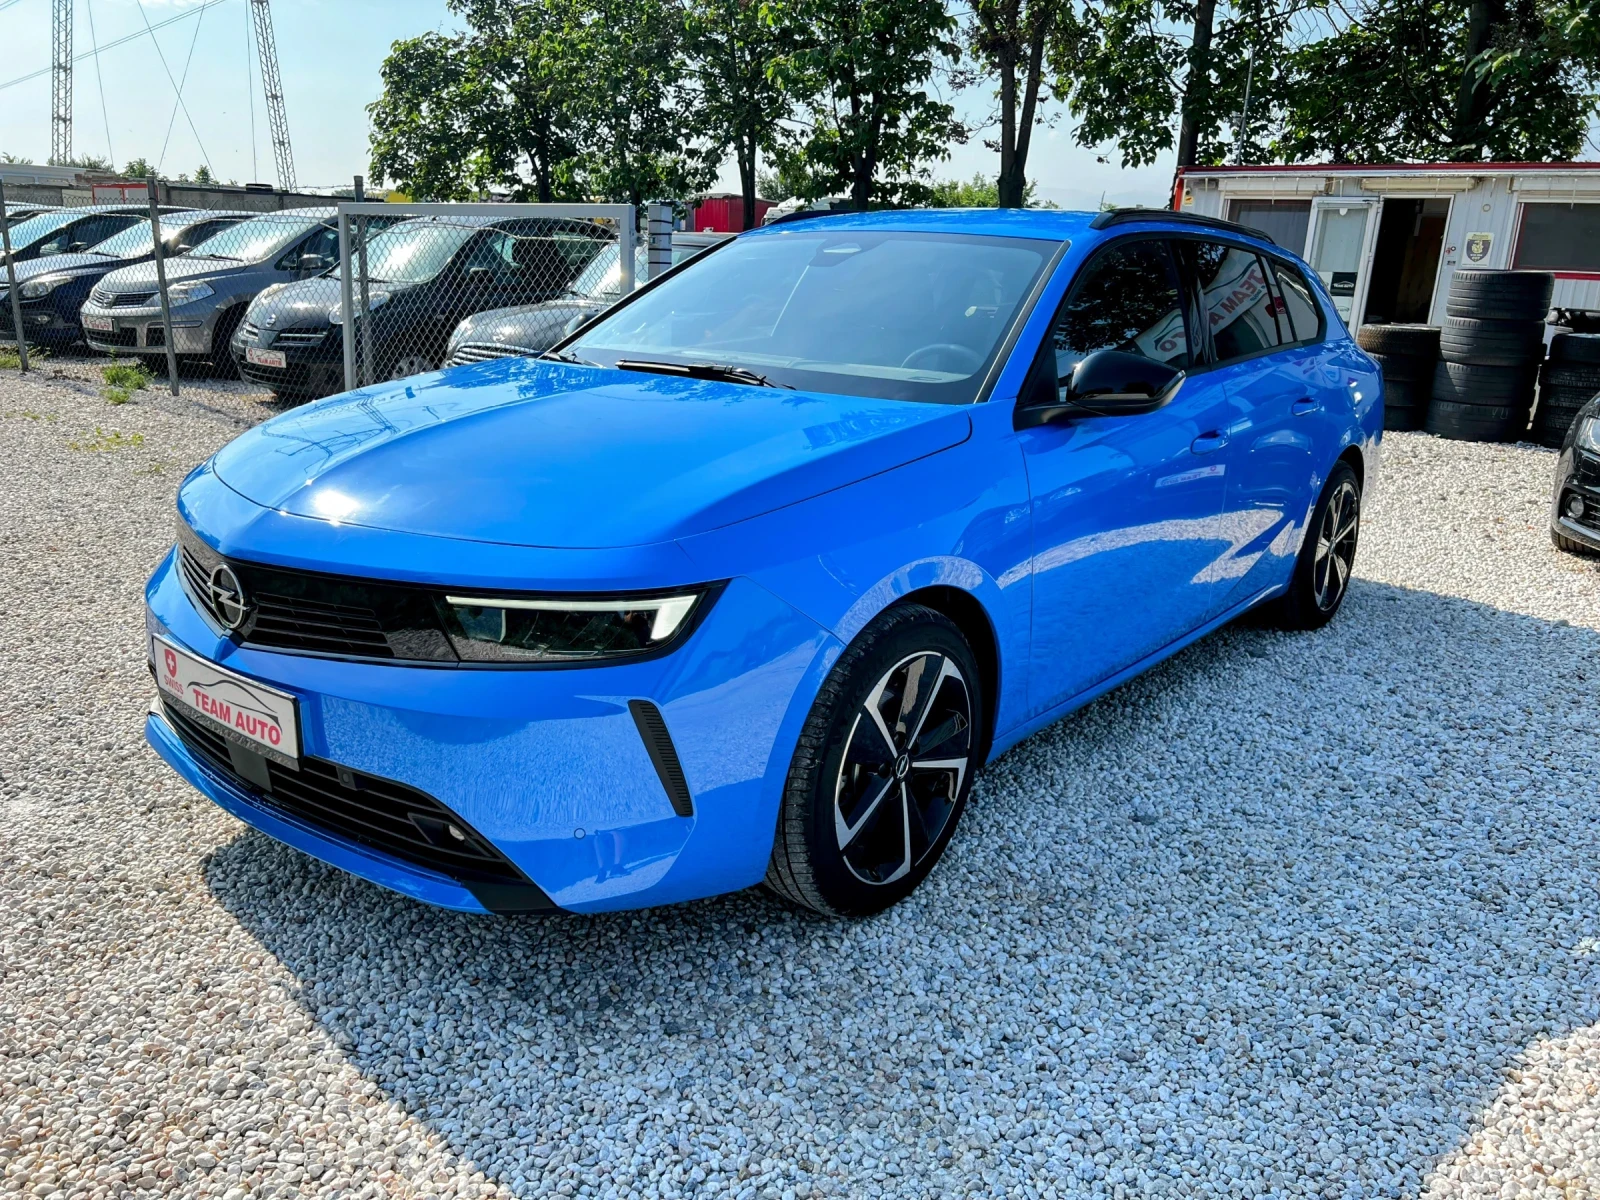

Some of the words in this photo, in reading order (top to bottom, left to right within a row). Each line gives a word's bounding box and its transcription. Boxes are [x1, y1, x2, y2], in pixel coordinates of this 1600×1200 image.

[164, 674, 184, 695] SWISS
[193, 688, 231, 724] TEAM
[235, 711, 281, 745] AUTO
